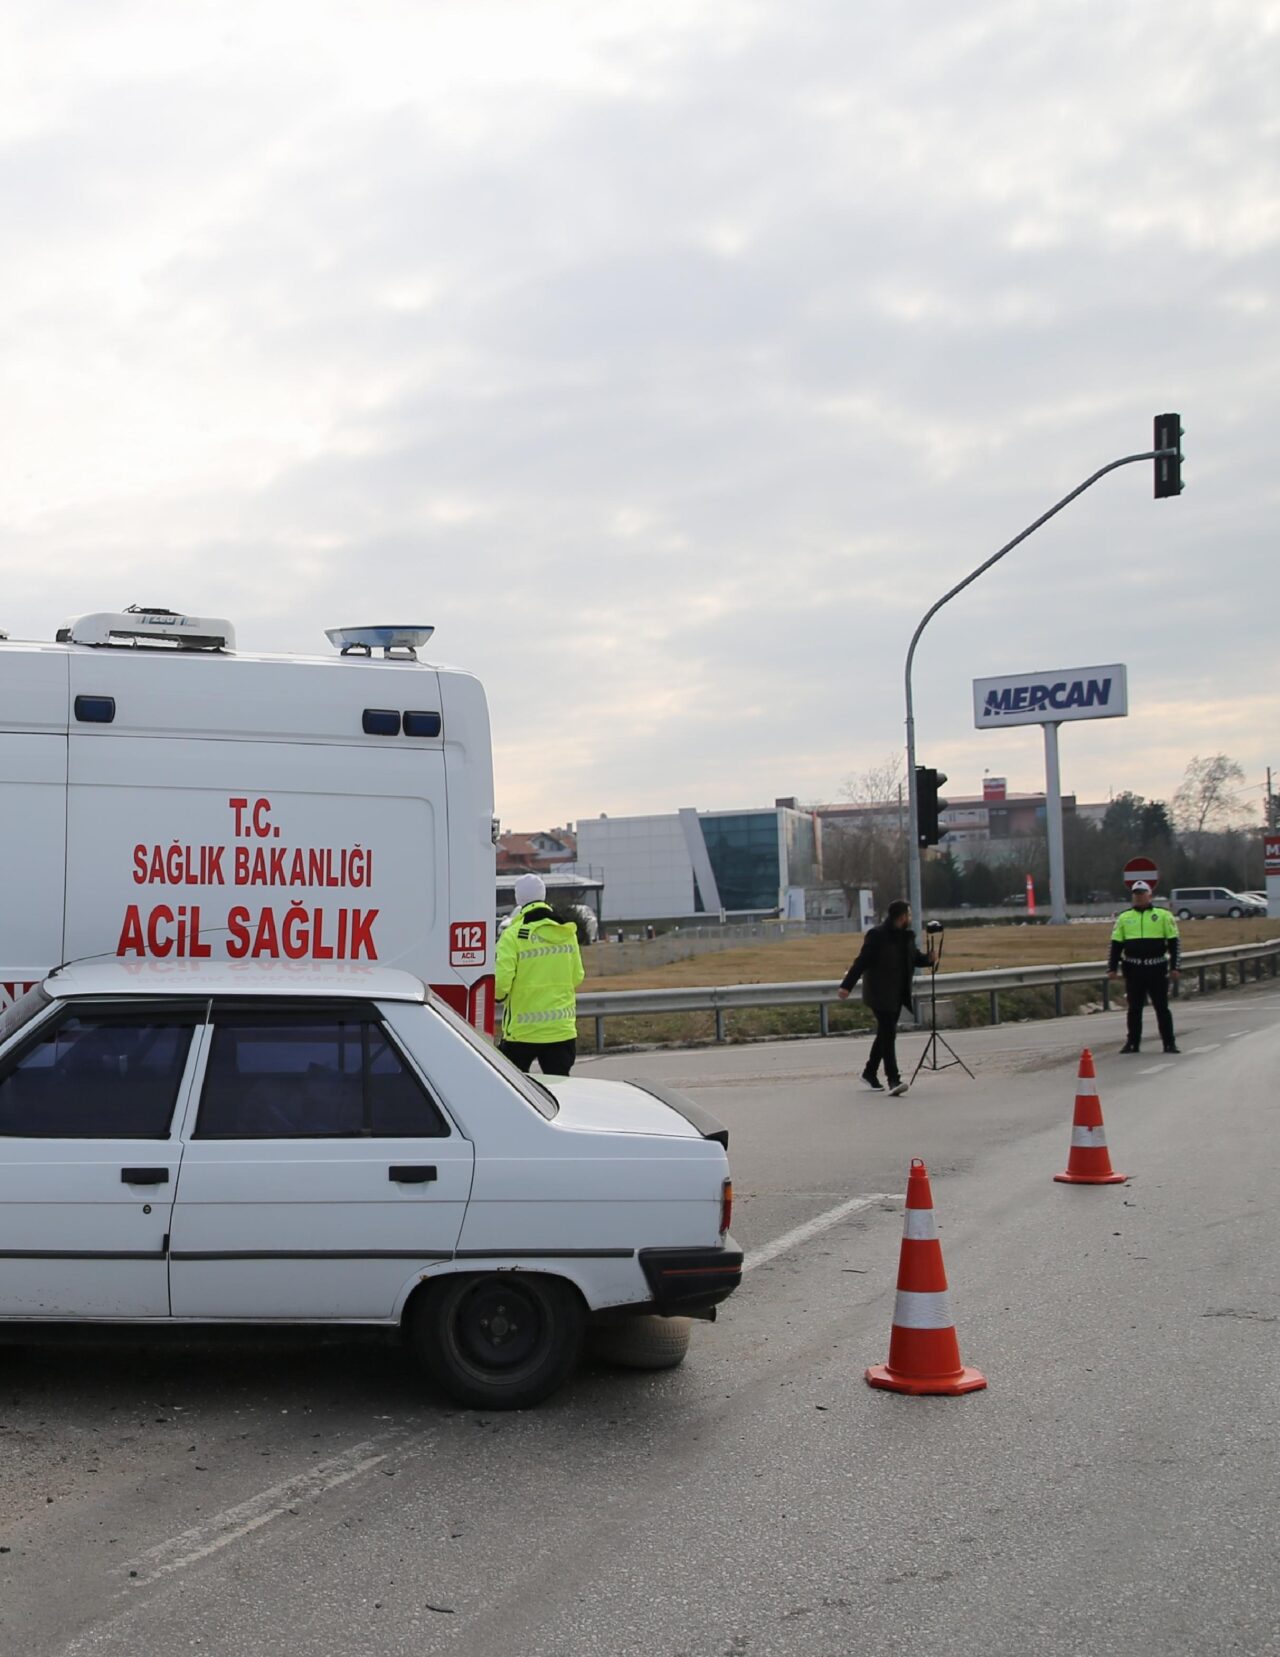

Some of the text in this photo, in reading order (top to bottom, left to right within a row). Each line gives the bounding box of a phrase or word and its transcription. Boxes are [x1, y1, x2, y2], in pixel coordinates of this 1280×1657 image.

[983, 678, 1112, 716] MERCAN
[228, 798, 280, 838] T.C.
[132, 839, 372, 888] SAĞLIK BAKANLIĞI
[226, 900, 380, 960] SAĞLIK
[455, 926, 482, 948] 112
